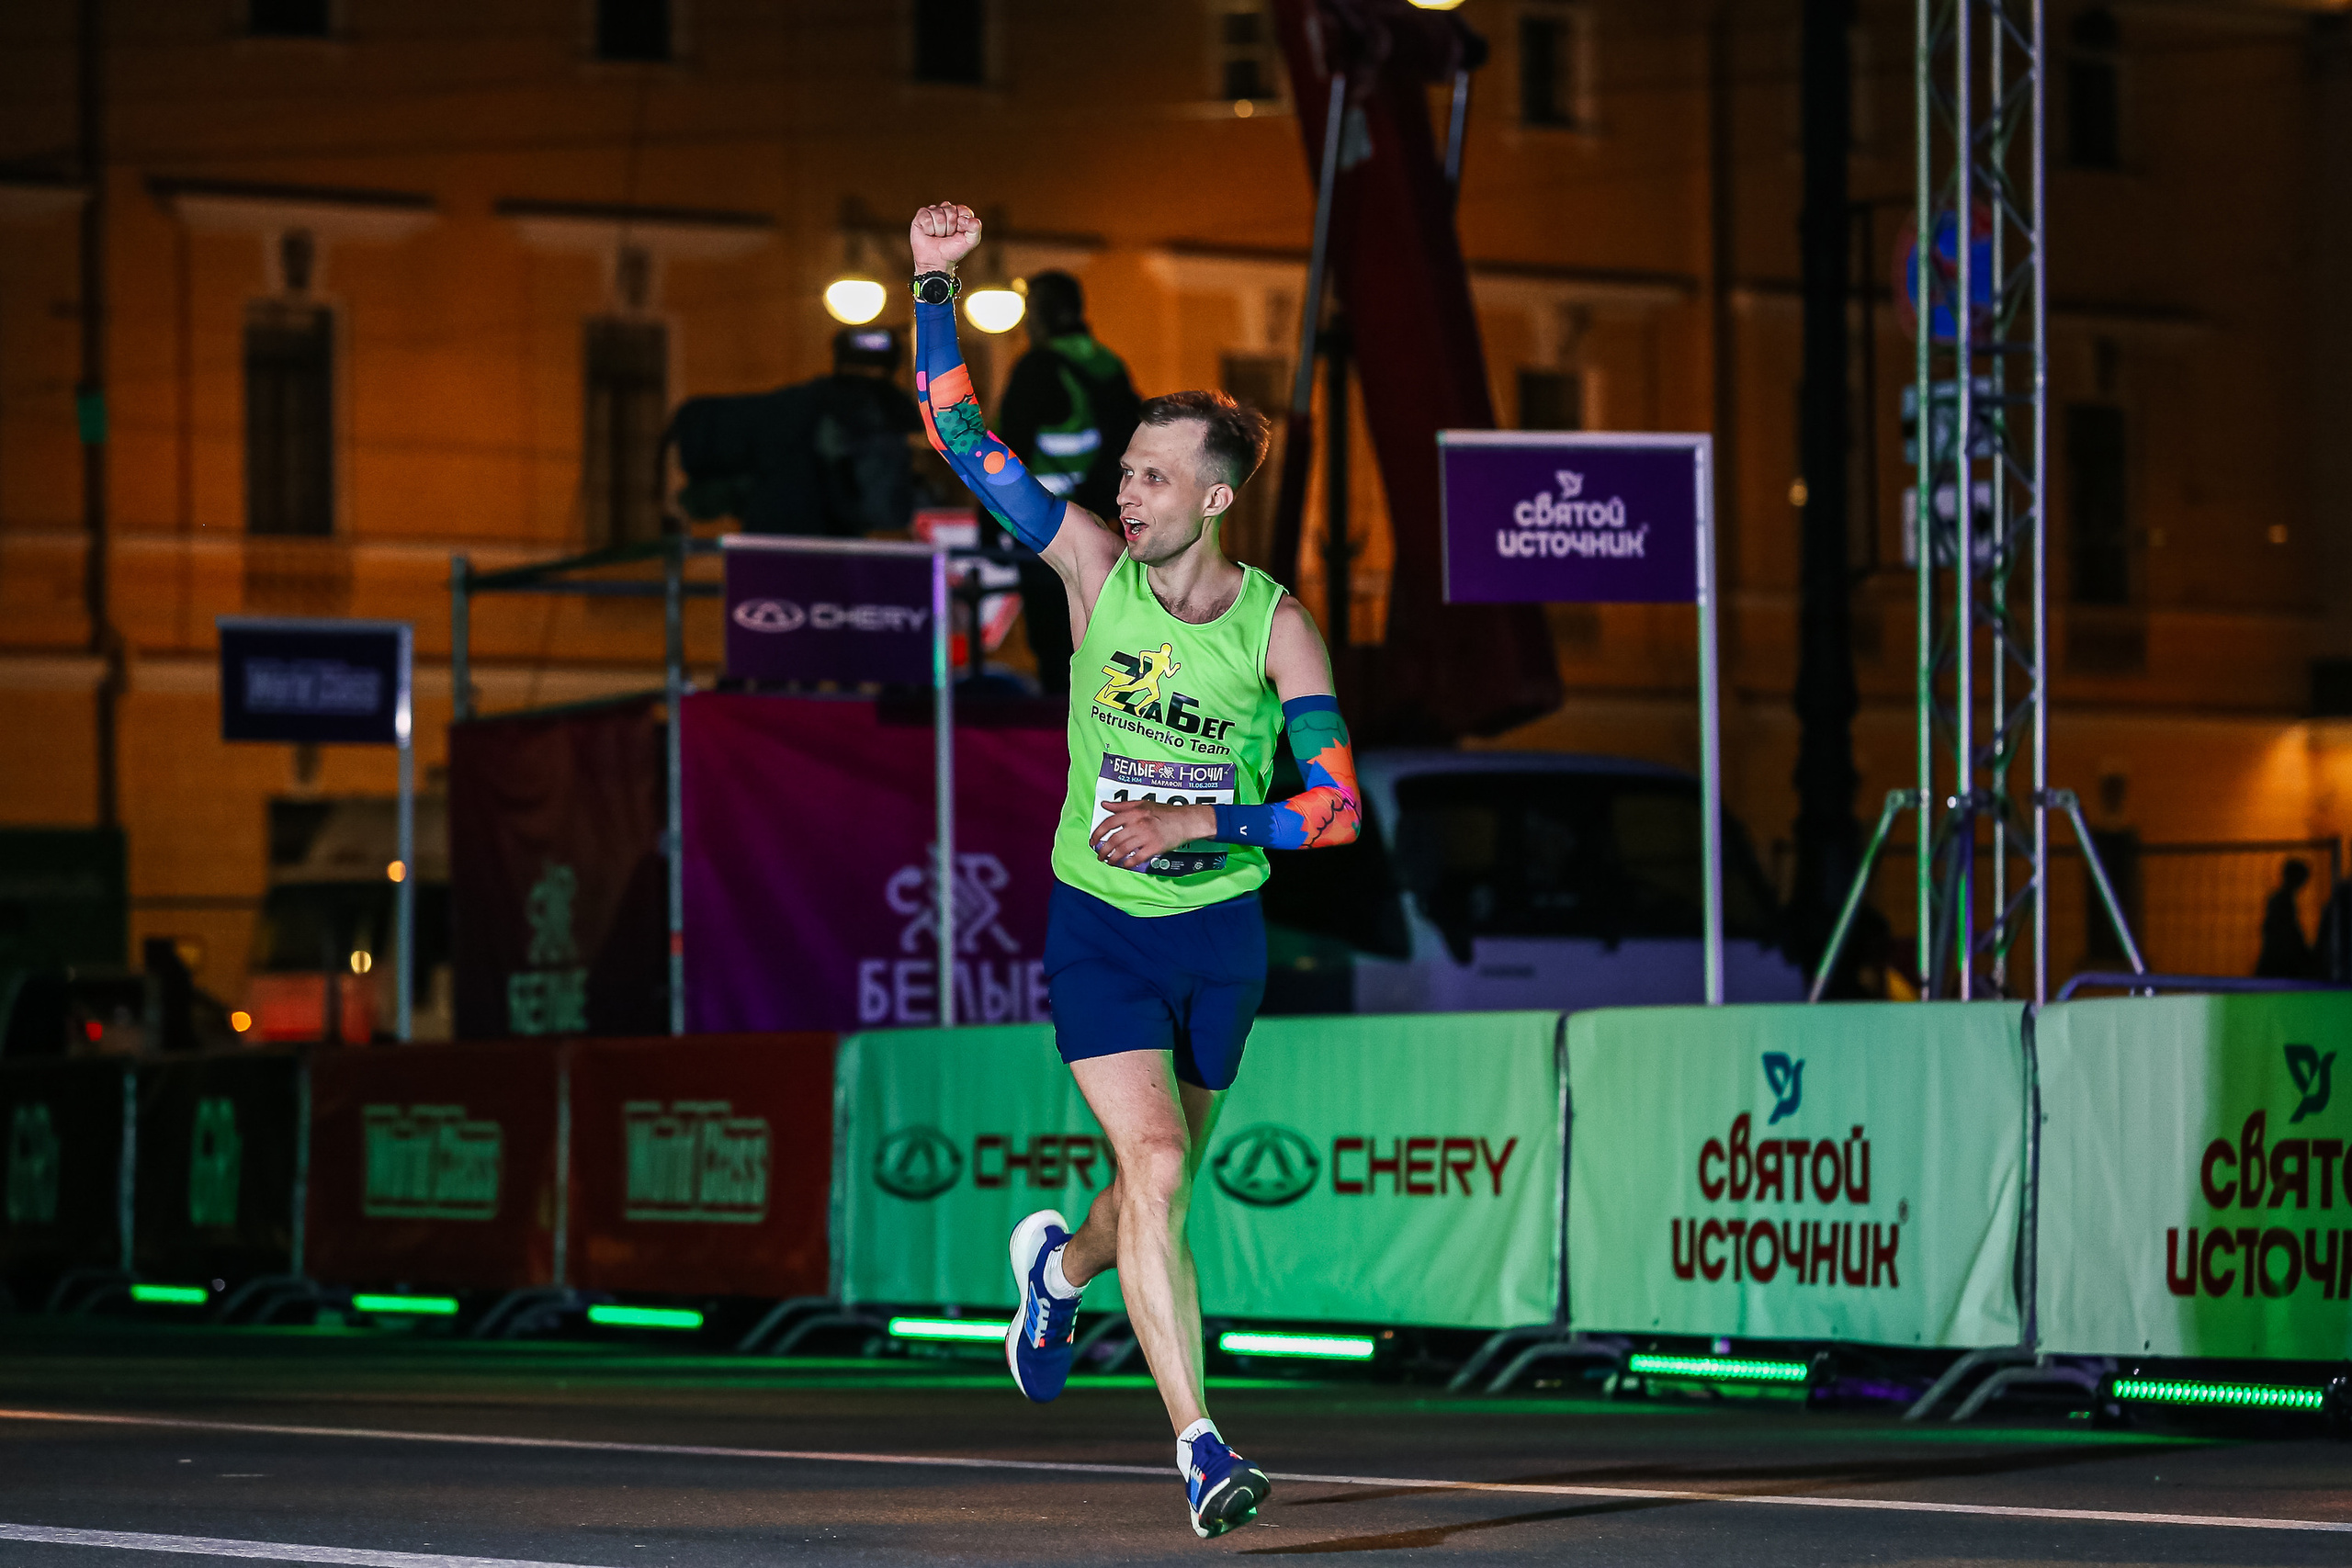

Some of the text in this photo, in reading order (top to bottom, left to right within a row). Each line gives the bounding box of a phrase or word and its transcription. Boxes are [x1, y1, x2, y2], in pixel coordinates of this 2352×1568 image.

[809, 603, 928, 632] CHERY
[1091, 705, 1231, 755] Petrushenko Team
[1114, 758, 1224, 782] БЕЛЫЕ НОЧИ
[1151, 779, 1182, 787] МАРАФОН
[1332, 1136, 1518, 1197] CHERY
